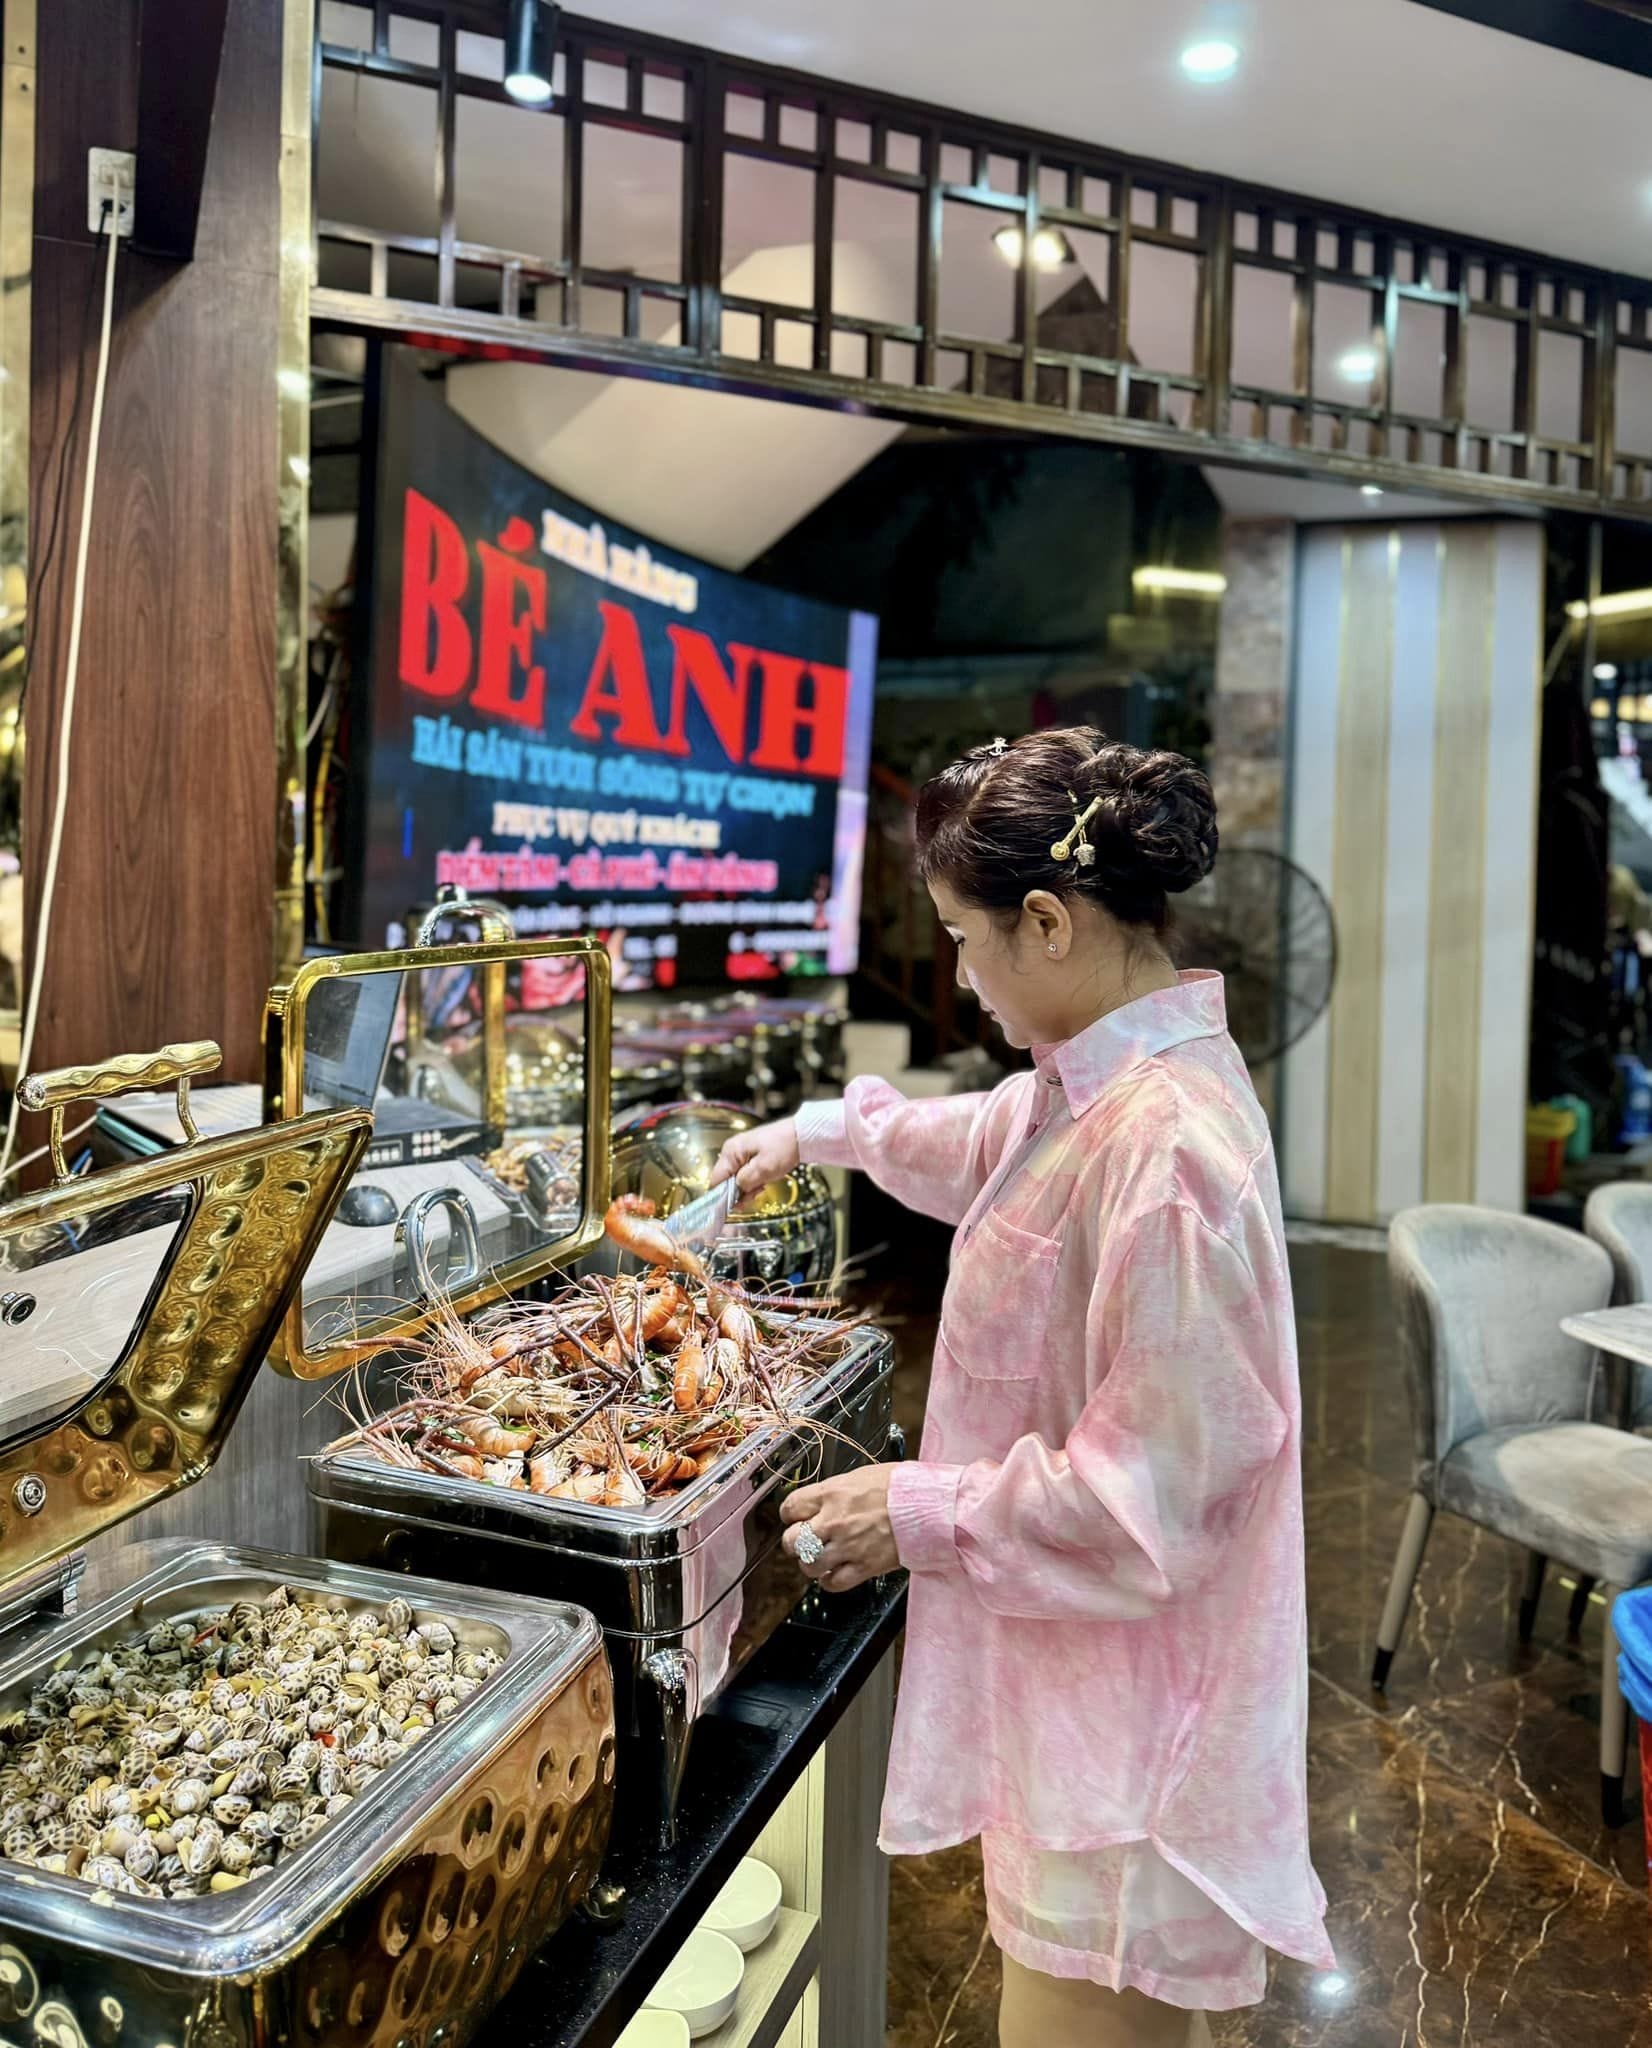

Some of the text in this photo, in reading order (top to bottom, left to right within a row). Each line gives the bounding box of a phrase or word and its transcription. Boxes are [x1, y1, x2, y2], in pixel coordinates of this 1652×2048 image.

[569, 598, 852, 778] ANH
[728, 776, 816, 821] CHỌN
[556, 807, 591, 846] VỤ
